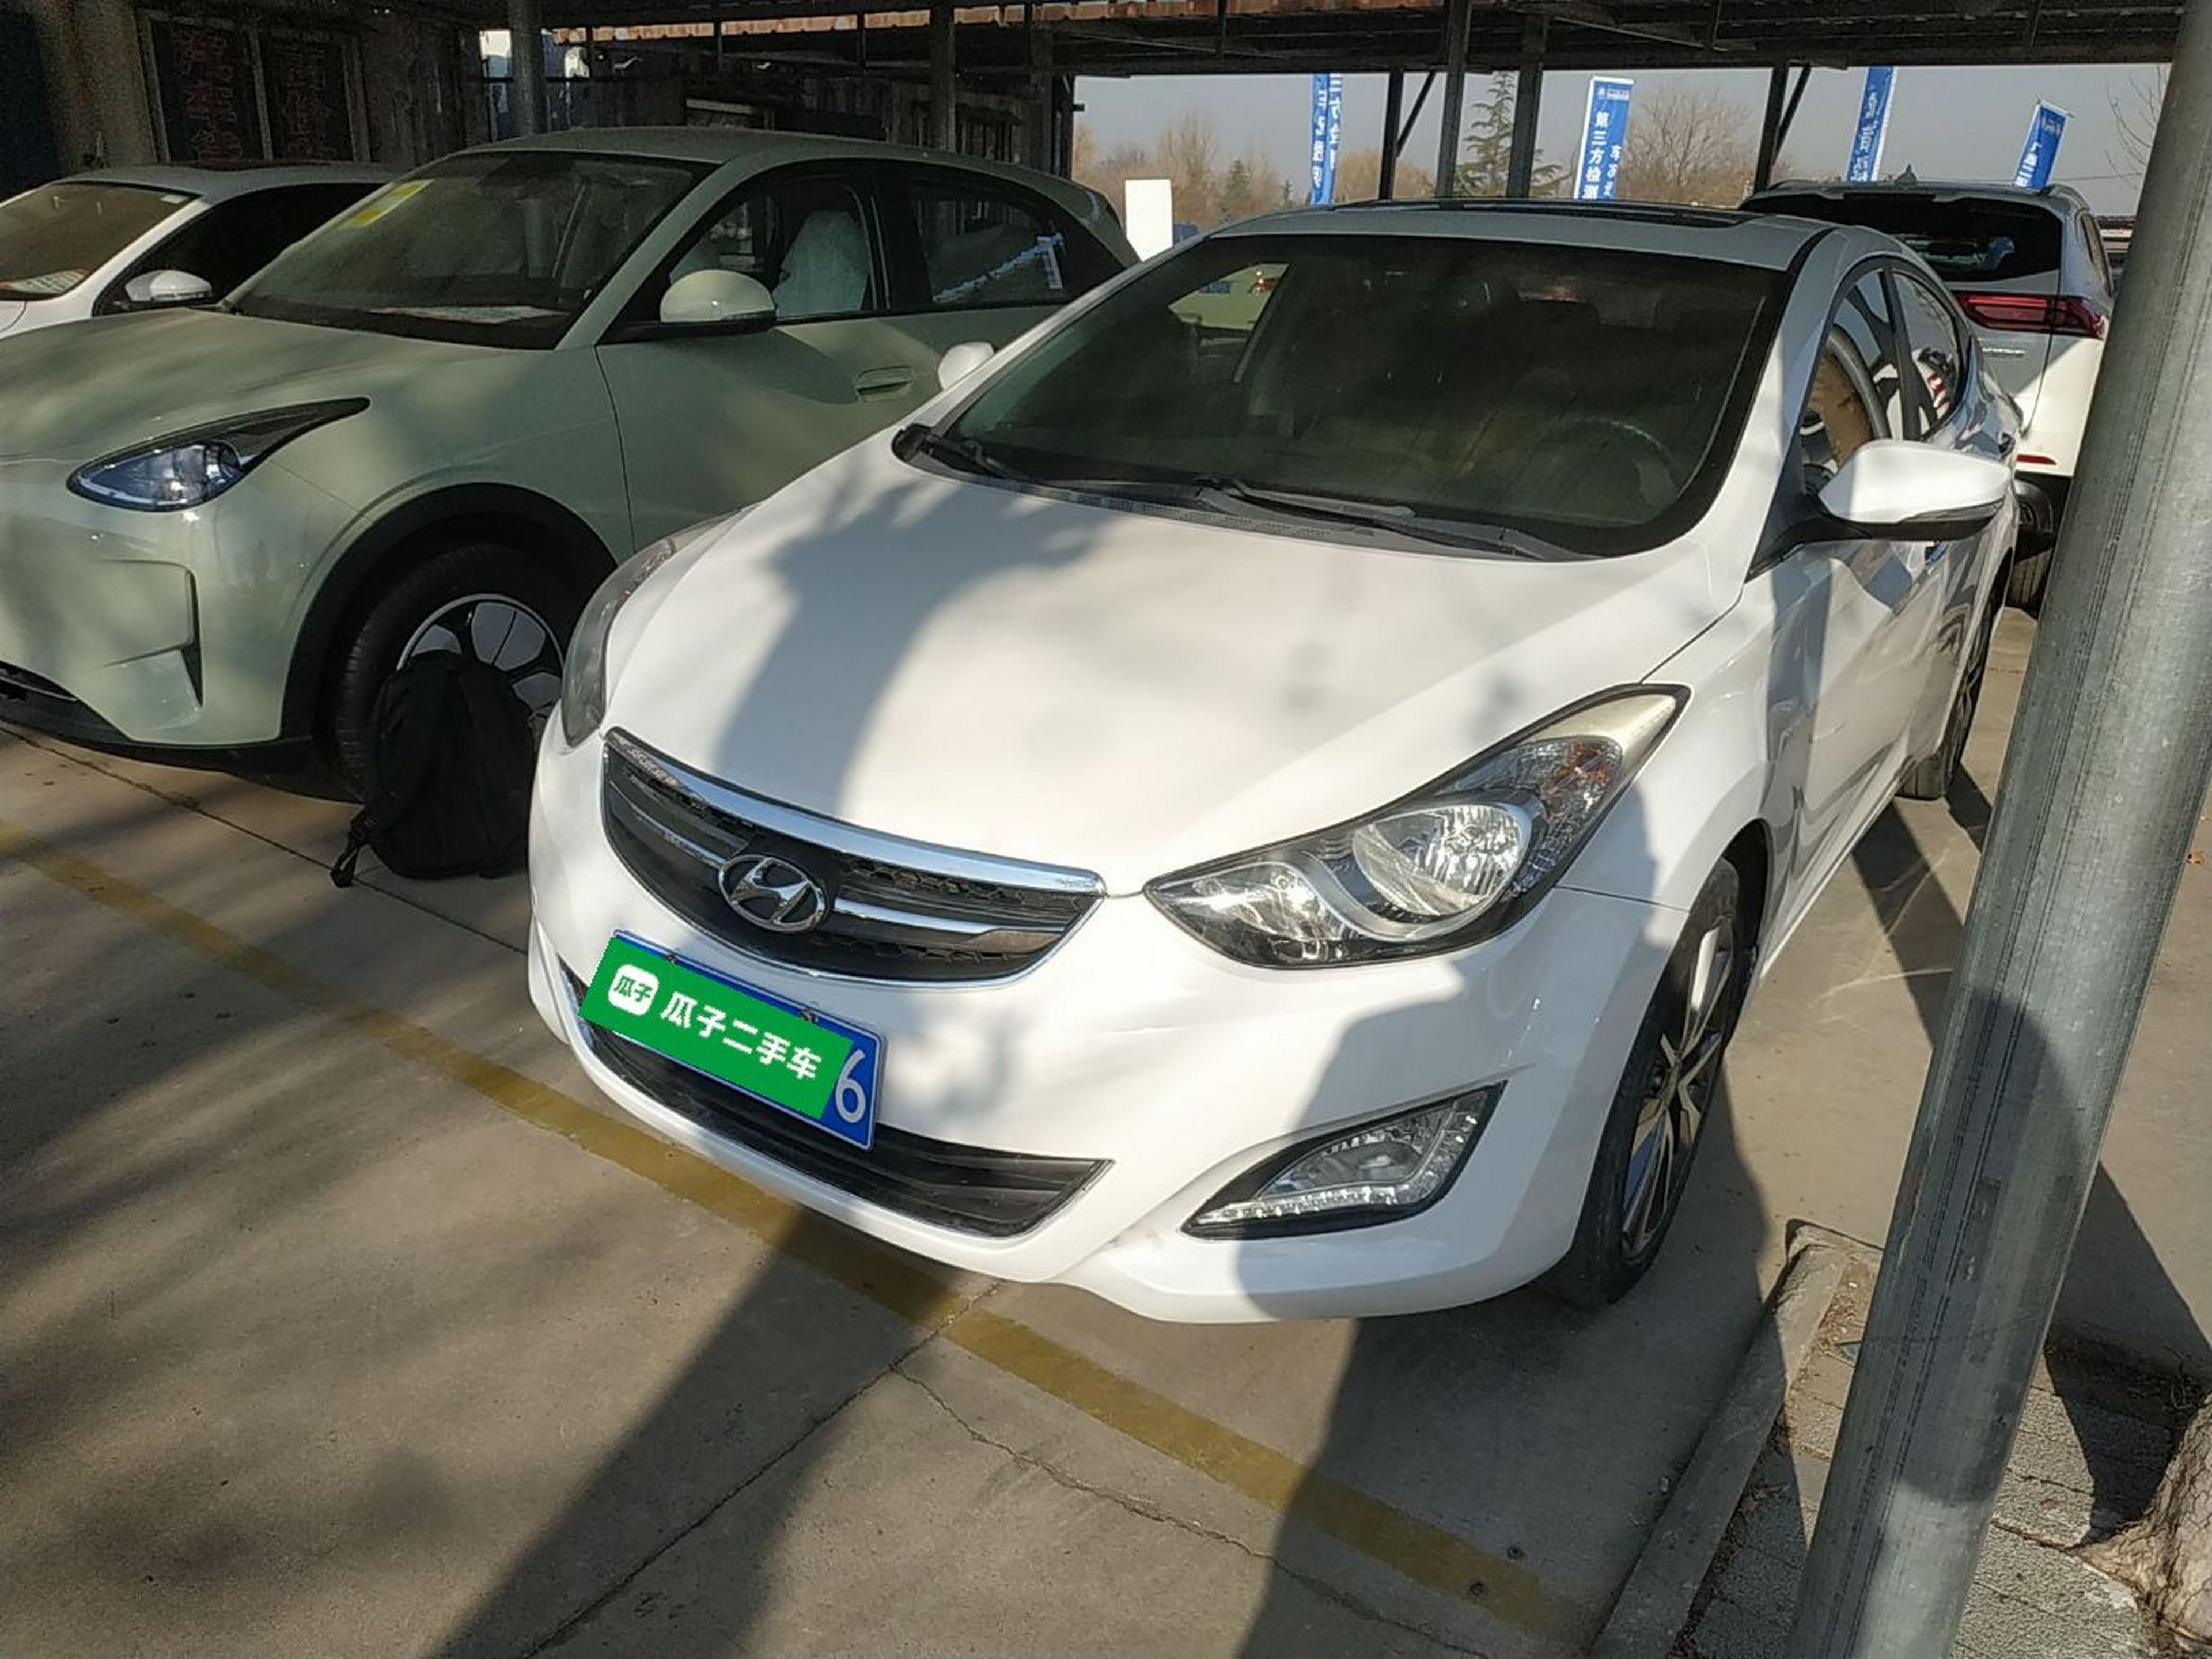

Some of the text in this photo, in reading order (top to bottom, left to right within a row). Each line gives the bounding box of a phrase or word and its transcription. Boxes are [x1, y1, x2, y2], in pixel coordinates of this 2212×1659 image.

[1582, 111, 1609, 199] 第三方检测
[835, 1049, 866, 1123] 6
